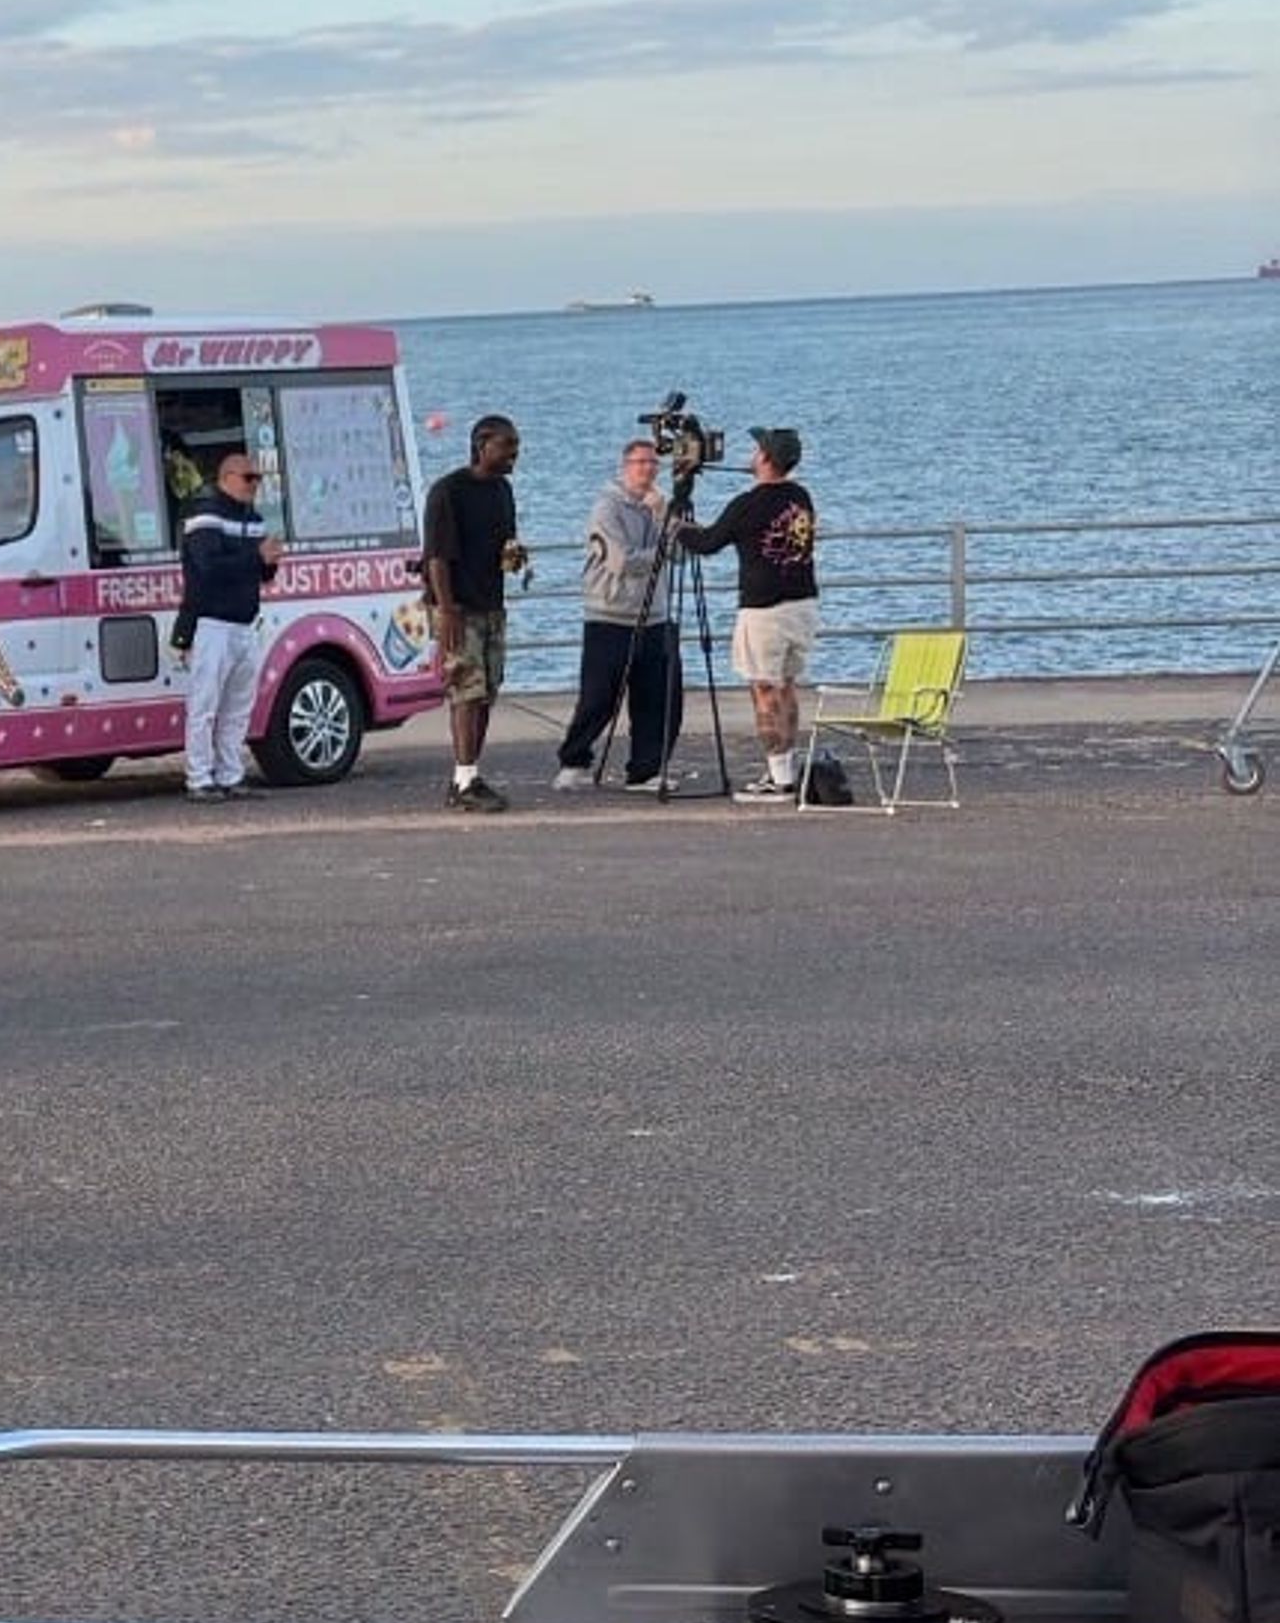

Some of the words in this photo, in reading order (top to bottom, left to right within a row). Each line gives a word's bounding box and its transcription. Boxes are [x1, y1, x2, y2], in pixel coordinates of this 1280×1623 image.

[151, 340, 195, 368] Mr
[199, 337, 313, 365] WHIPPY
[327, 559, 373, 590] FOR
